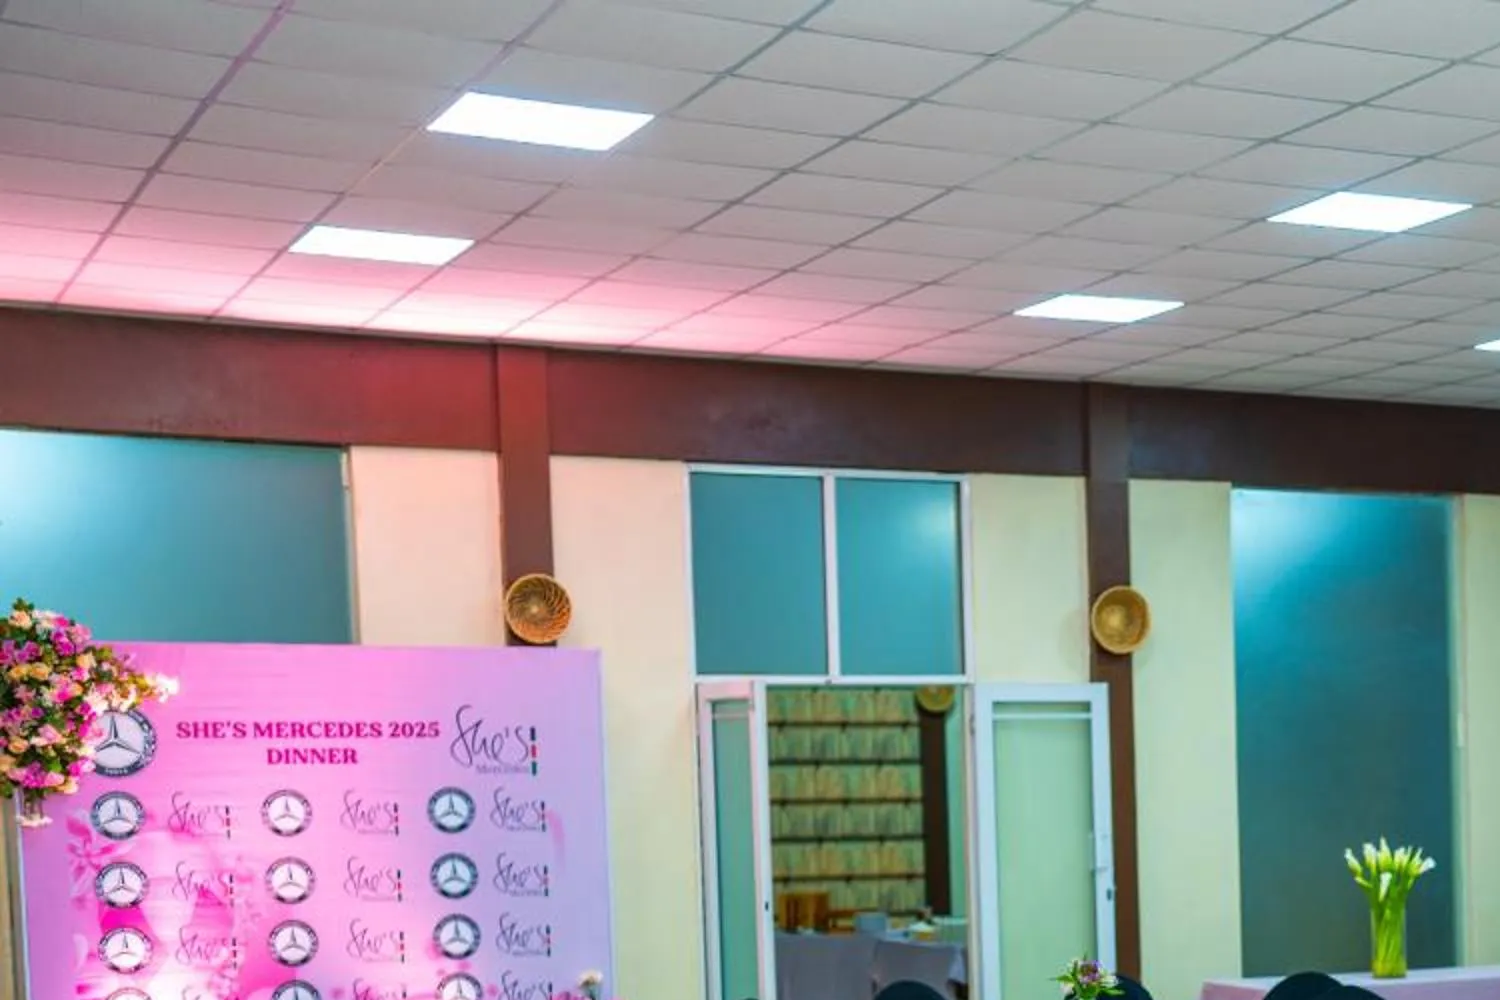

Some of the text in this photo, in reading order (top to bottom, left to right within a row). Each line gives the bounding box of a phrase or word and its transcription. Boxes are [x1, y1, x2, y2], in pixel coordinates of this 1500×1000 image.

[176, 720, 440, 738] SHE'S MERCEDES 2025
[266, 748, 358, 765] DINNER
